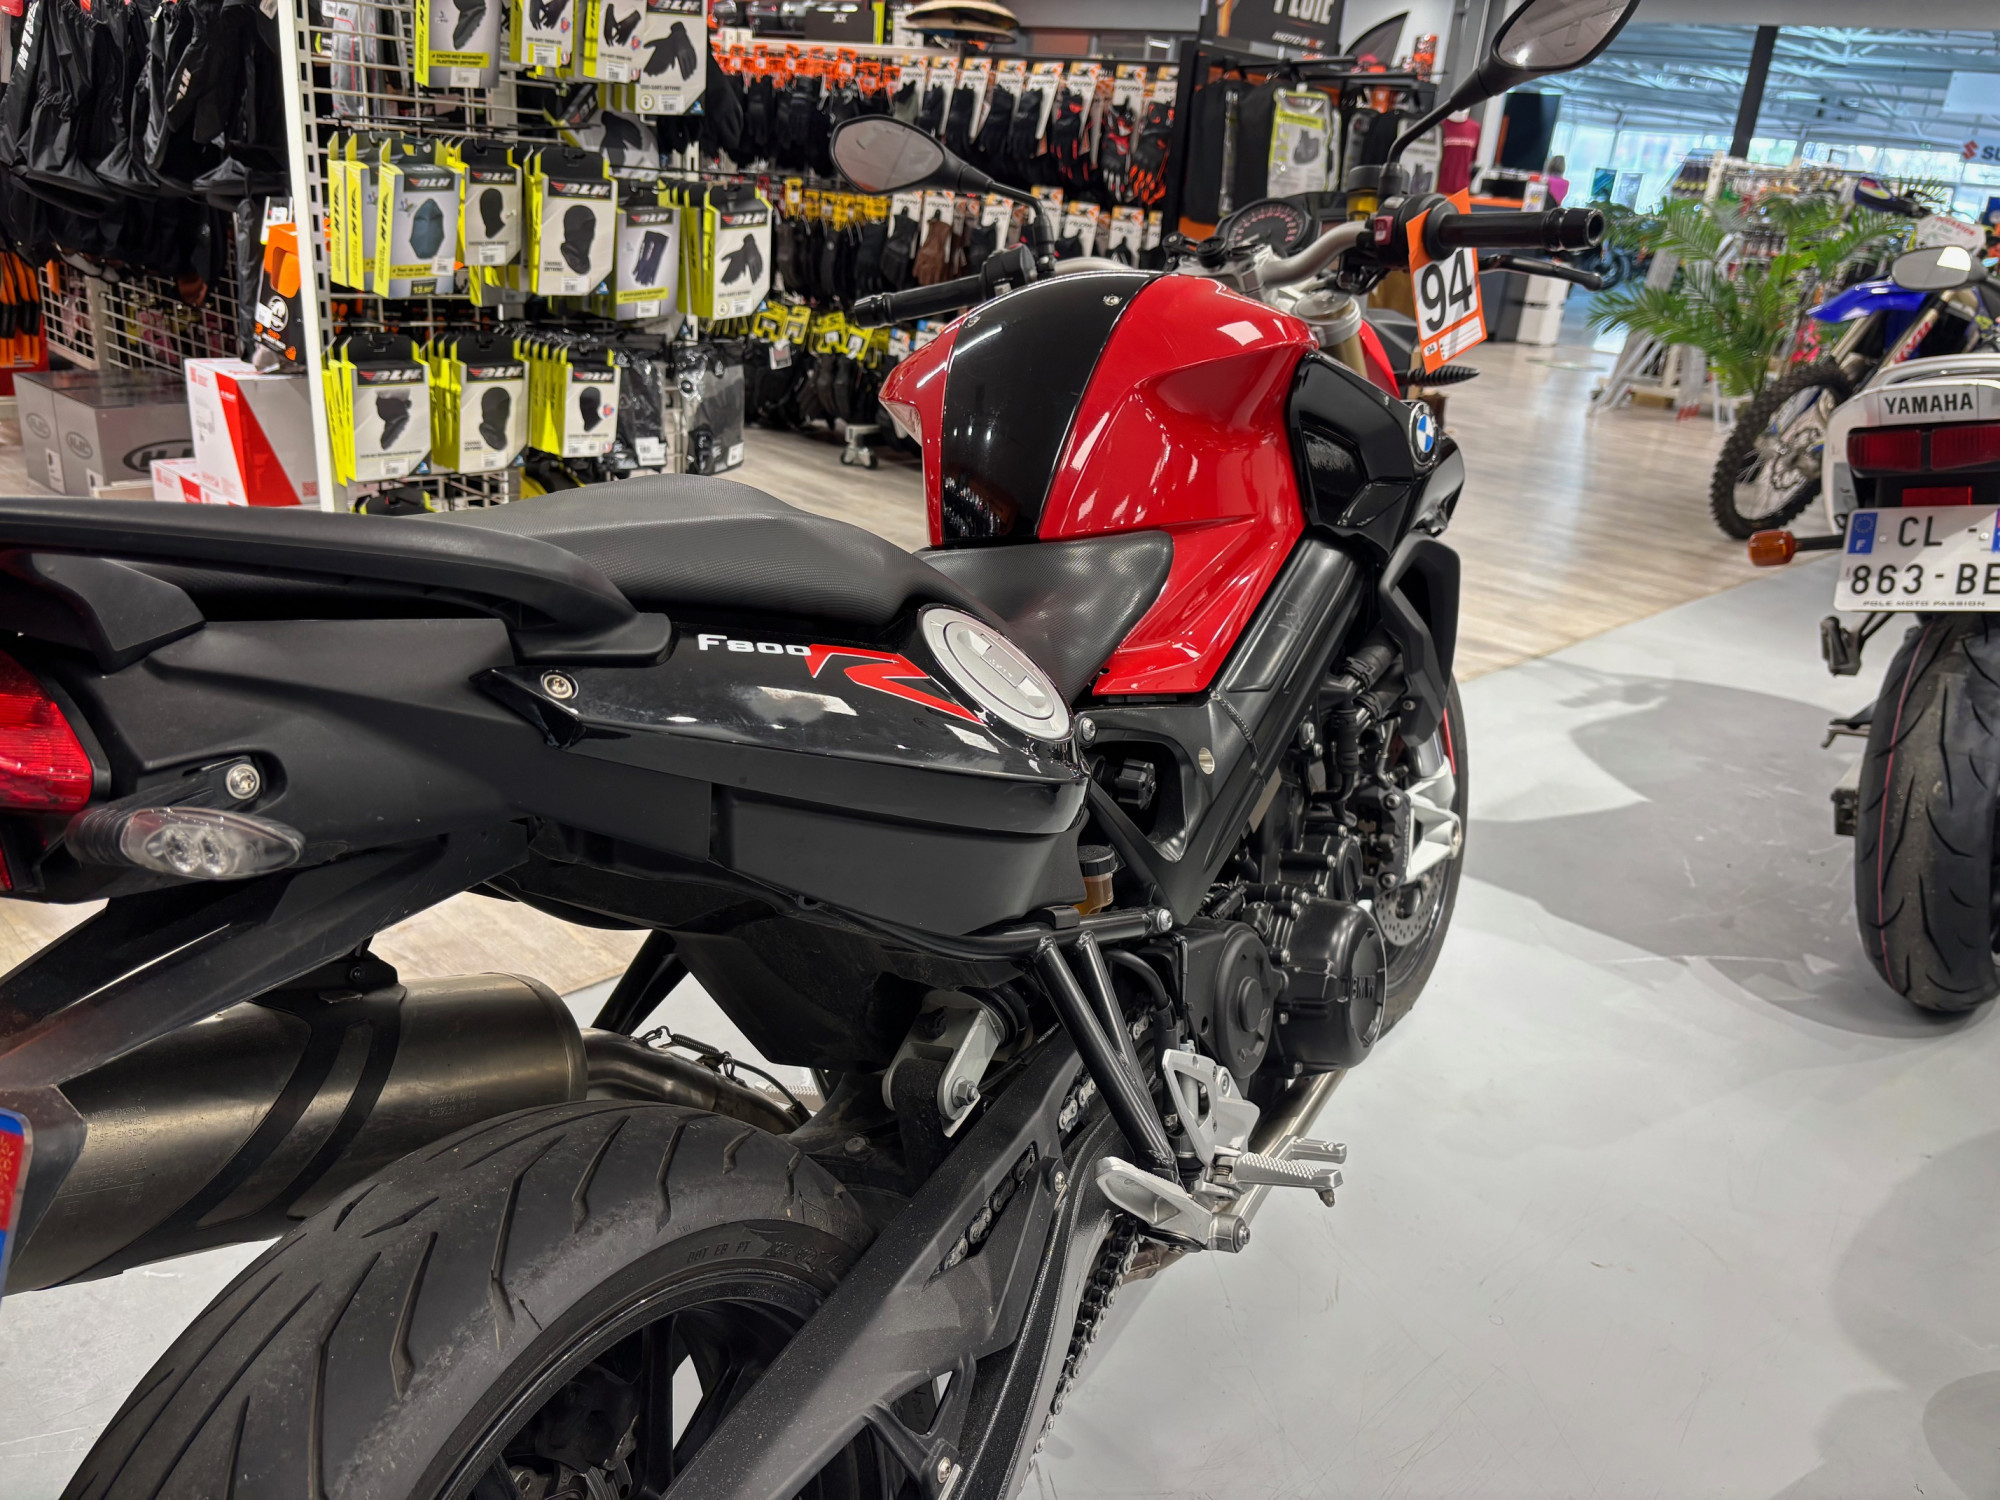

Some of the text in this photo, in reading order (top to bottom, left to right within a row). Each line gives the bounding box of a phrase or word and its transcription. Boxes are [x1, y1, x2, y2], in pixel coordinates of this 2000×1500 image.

[417, 178, 450, 188] BLH
[563, 182, 610, 195] BLH
[731, 213, 766, 225] BLH
[1421, 249, 1472, 332] 94
[373, 369, 422, 381] BLH
[480, 367, 523, 378] BLH
[1885, 392, 1973, 414] YAMAHA
[1855, 539, 1866, 552] F
[1353, 976, 1376, 999] BMW
